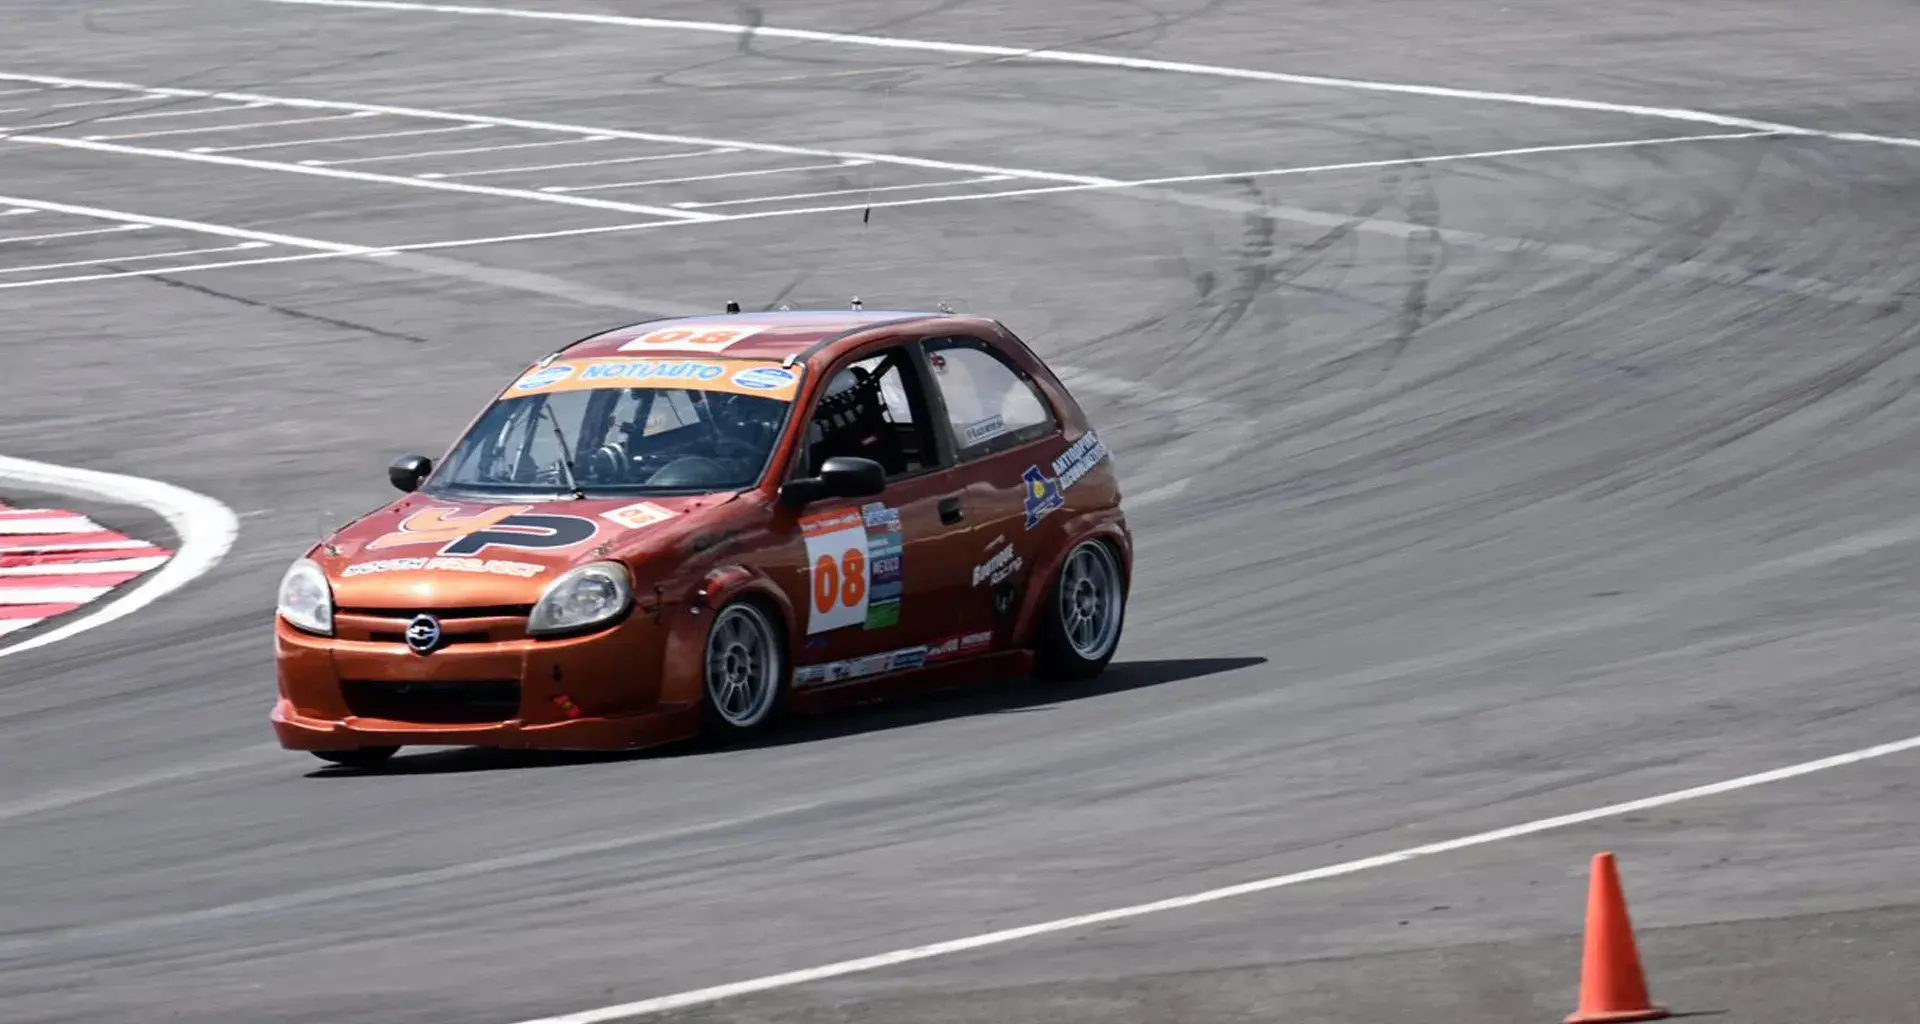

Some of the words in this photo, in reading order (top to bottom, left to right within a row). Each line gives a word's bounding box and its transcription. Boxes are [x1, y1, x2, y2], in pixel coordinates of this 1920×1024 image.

[644, 328, 740, 345] 08
[580, 360, 726, 382] NOTIAUTO
[619, 508, 657, 524] 08
[814, 547, 866, 614] 08
